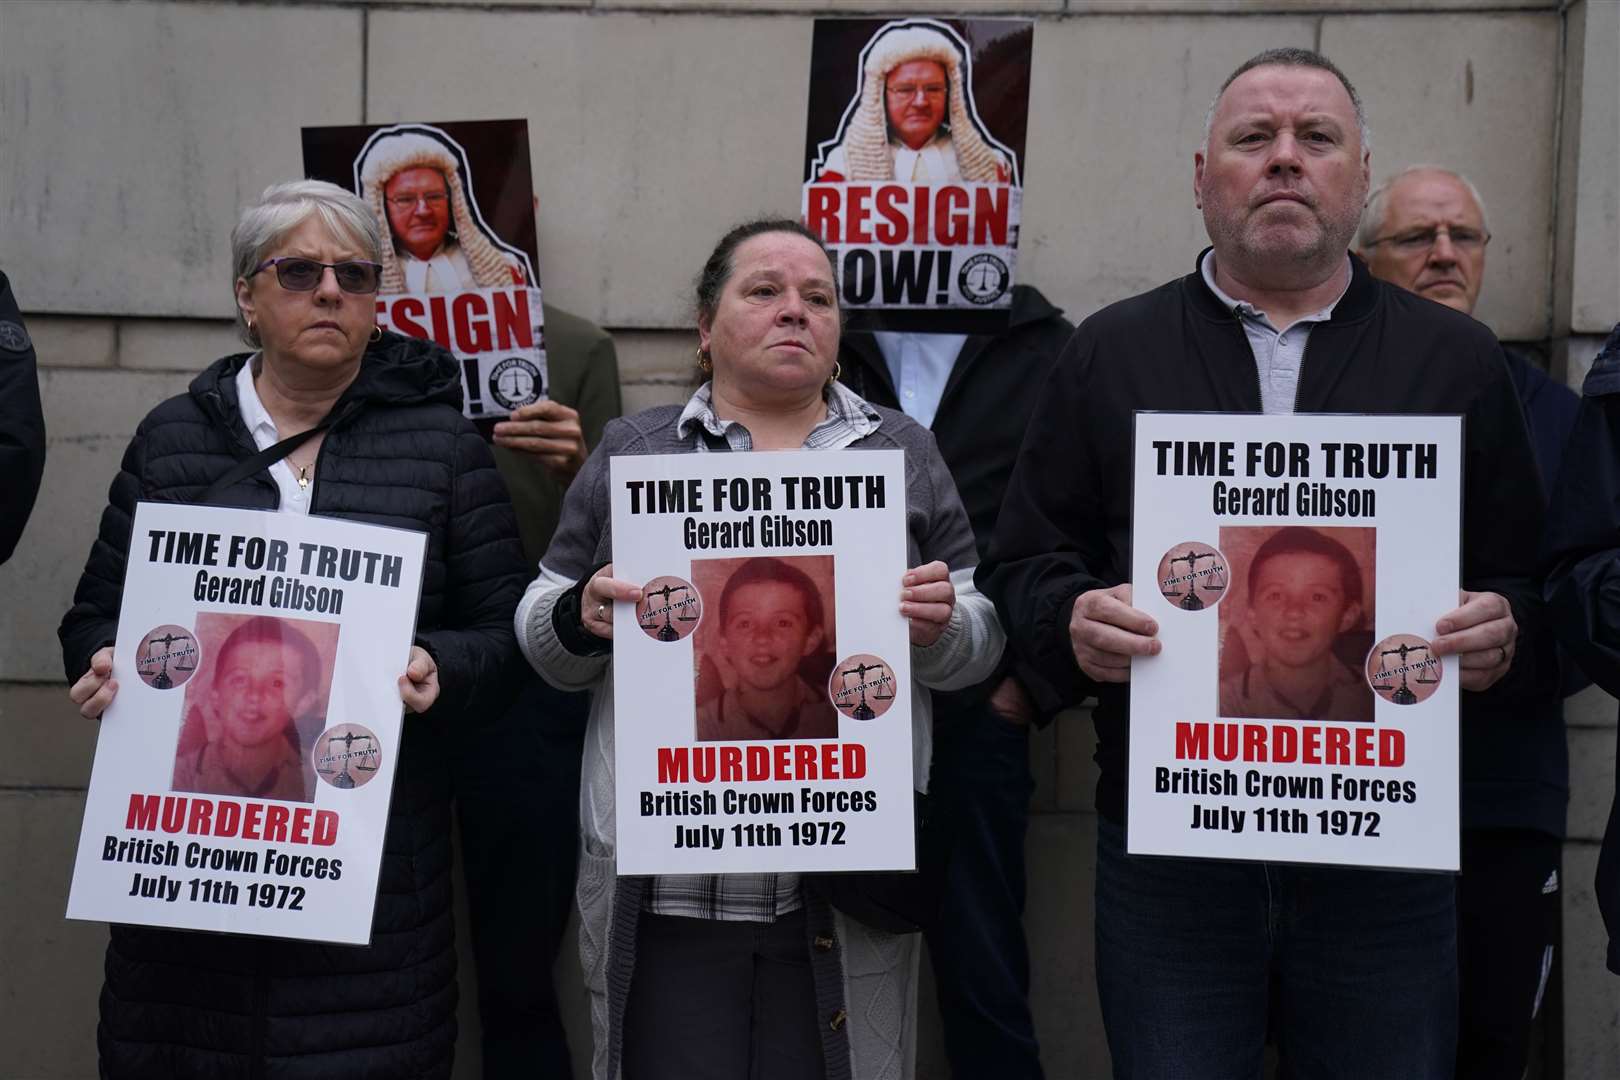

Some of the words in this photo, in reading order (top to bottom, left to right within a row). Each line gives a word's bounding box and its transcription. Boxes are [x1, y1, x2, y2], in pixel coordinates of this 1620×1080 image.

[808, 186, 1009, 246] RESIGN
[376, 290, 533, 354] SIGN
[1153, 441, 1234, 476] TIME
[1246, 442, 1309, 477] FOR
[1321, 443, 1437, 479] TRUTH
[626, 479, 703, 514] TIME
[713, 478, 771, 512] FOR
[781, 476, 885, 510] TRUTH
[1213, 481, 1289, 516] Gerard
[1296, 482, 1375, 517] Gibson
[684, 516, 754, 549] Gerard
[761, 515, 832, 547] Gibson
[149, 530, 221, 567] TIME
[228, 536, 288, 572] FOR
[300, 543, 402, 587] TRUTH
[1163, 578, 1180, 586] TIME
[1182, 573, 1197, 581] FOR
[1198, 566, 1224, 577] TRUTH
[194, 569, 266, 606] Gerard
[269, 575, 343, 614] Gibson
[641, 611, 657, 620] TIME
[658, 606, 672, 614] FOR
[673, 598, 696, 609] TRUTH
[836, 690, 852, 698] TIME
[853, 684, 868, 692] FOR
[869, 676, 892, 687] TRUTH
[1374, 671, 1392, 680] TIME
[1394, 666, 1410, 674] FOR
[1411, 658, 1438, 669] TRUTH
[658, 744, 866, 783] MURDERED
[1176, 722, 1405, 767] MURDERED
[641, 789, 716, 817] British
[723, 789, 794, 815] Crown
[801, 788, 876, 813] Forces
[1156, 767, 1237, 796] British
[1246, 770, 1323, 799] Crown
[1332, 774, 1416, 804] Forces
[126, 794, 339, 846] MURDERED
[674, 824, 724, 850] July
[731, 823, 781, 847] 11th
[789, 822, 845, 846] 1972
[1191, 805, 1245, 834] July
[1253, 808, 1308, 834] 11th
[1316, 810, 1380, 837] 1972
[102, 836, 179, 867] British
[185, 842, 258, 873] Crown
[264, 849, 342, 880] Forces
[129, 872, 181, 903] July
[189, 878, 238, 905] 11th
[247, 883, 305, 910] 1972
